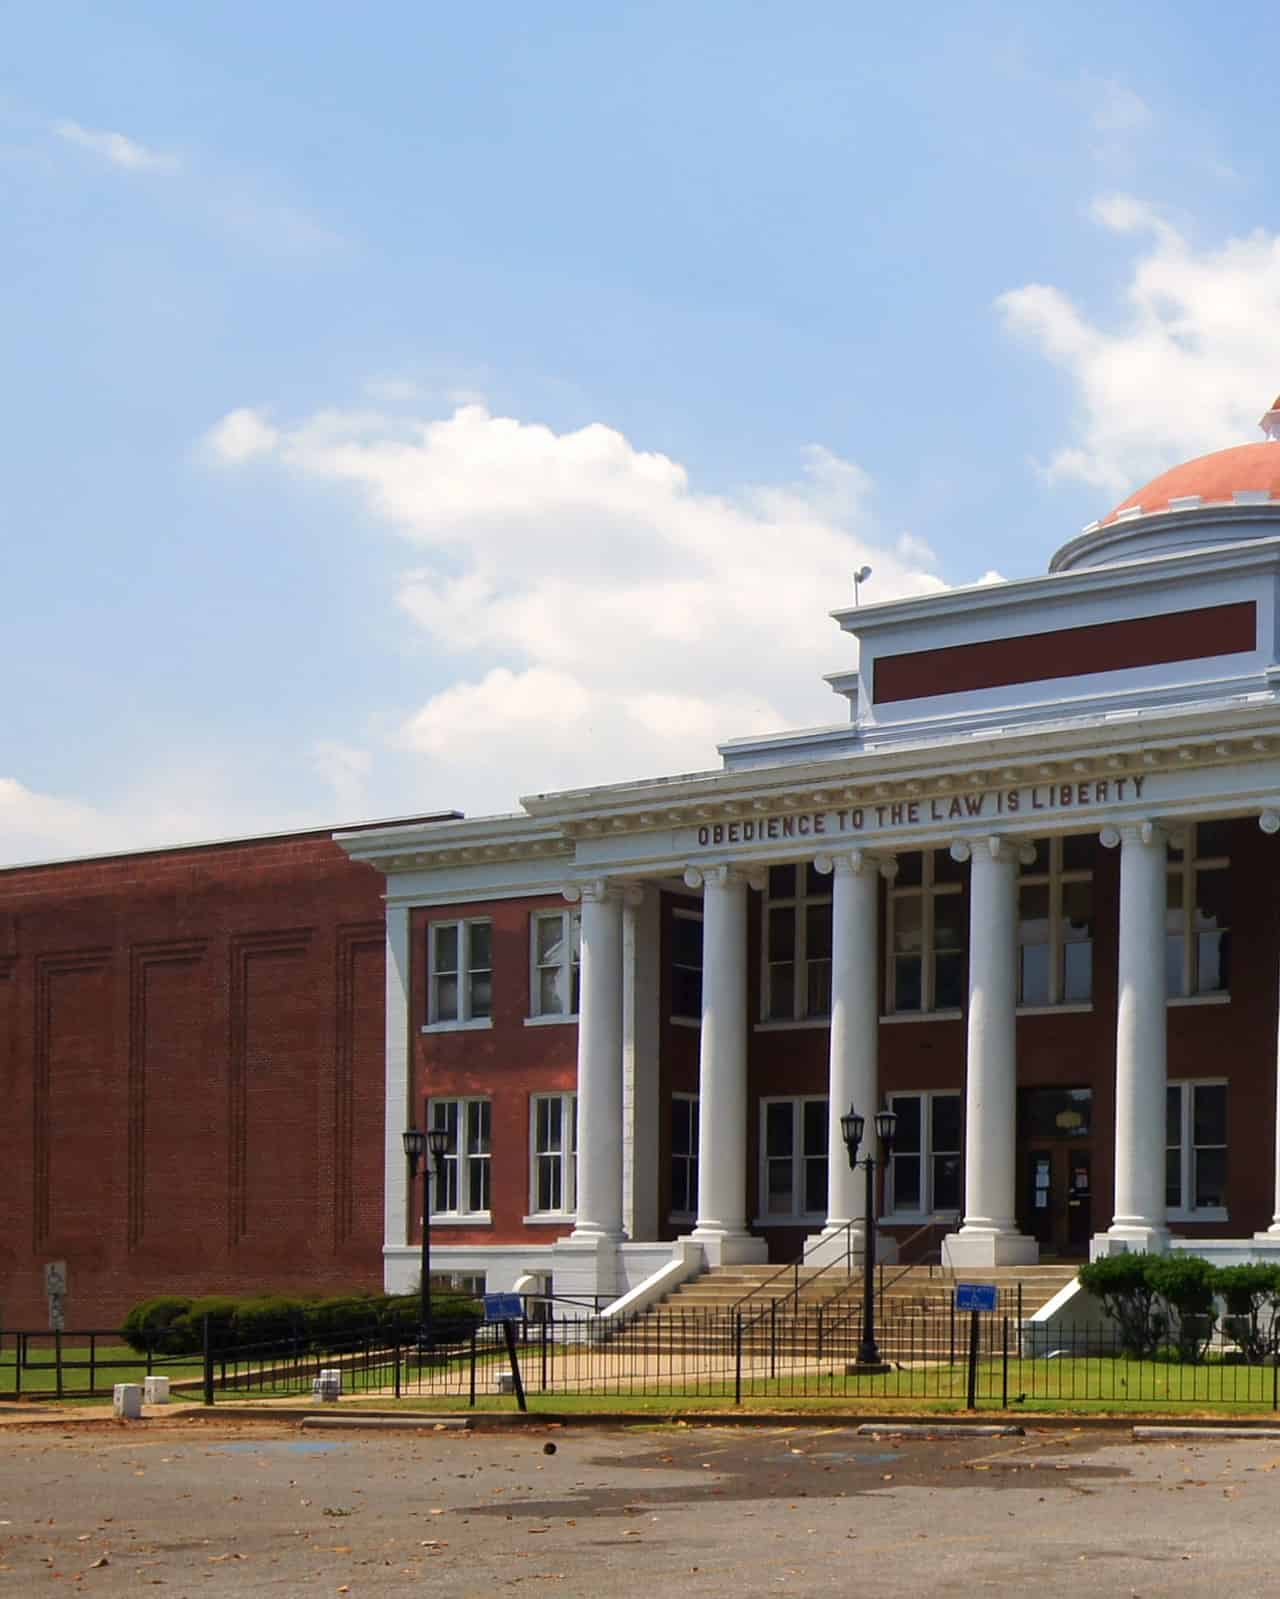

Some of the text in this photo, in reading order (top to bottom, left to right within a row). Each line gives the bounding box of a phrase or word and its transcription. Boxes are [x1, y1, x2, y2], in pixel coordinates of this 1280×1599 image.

[697, 775, 1145, 846] OBEDIENCE TO THE LAW IS LIBERTY
